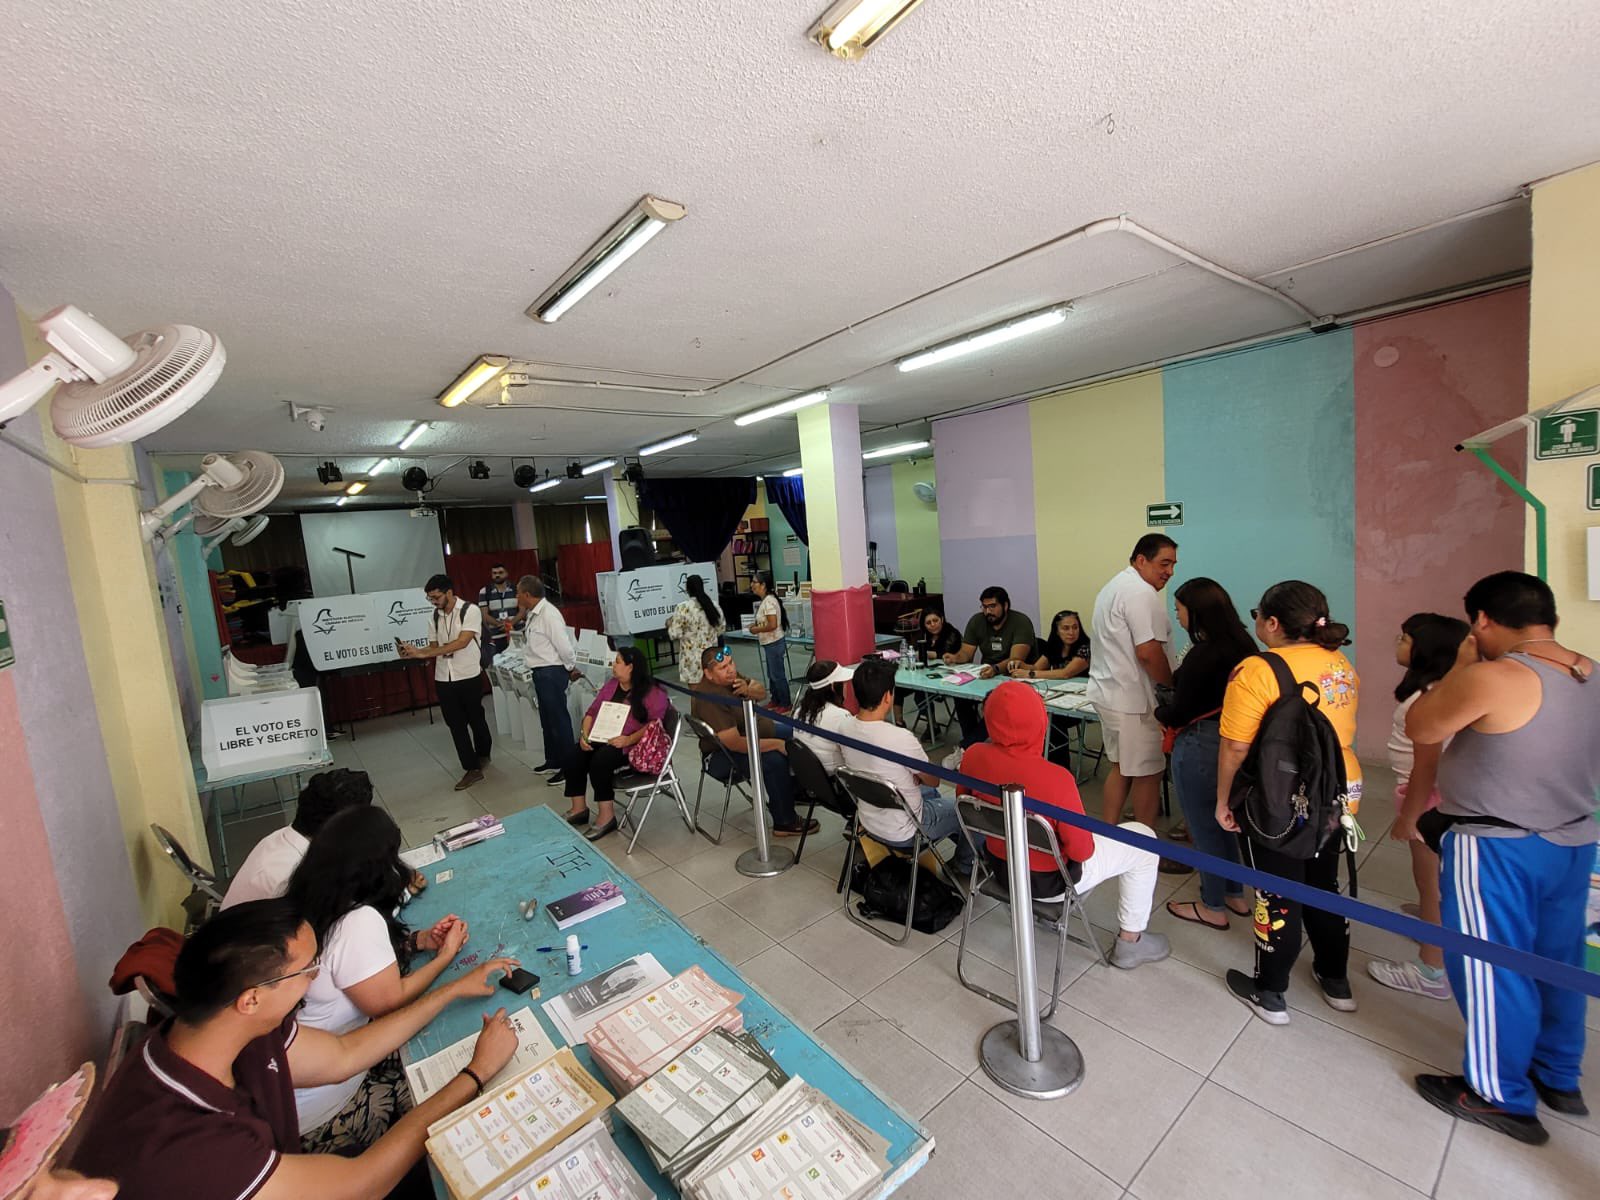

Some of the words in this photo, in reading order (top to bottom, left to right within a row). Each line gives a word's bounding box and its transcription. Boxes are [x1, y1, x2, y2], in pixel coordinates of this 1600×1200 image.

[634, 610, 641, 619] EL
[642, 606, 657, 618] VOTO
[658, 605, 666, 615] ES
[324, 651, 334, 661] EL
[336, 648, 357, 659] VOTO
[359, 646, 369, 656] ES
[371, 642, 393, 654] LIBRE
[235, 726, 251, 736] EL
[252, 721, 284, 733] VOTO
[287, 719, 301, 729] ES
[220, 738, 254, 751] LIBRE
[256, 736, 264, 745] Y
[267, 728, 318, 743] SECRETO
